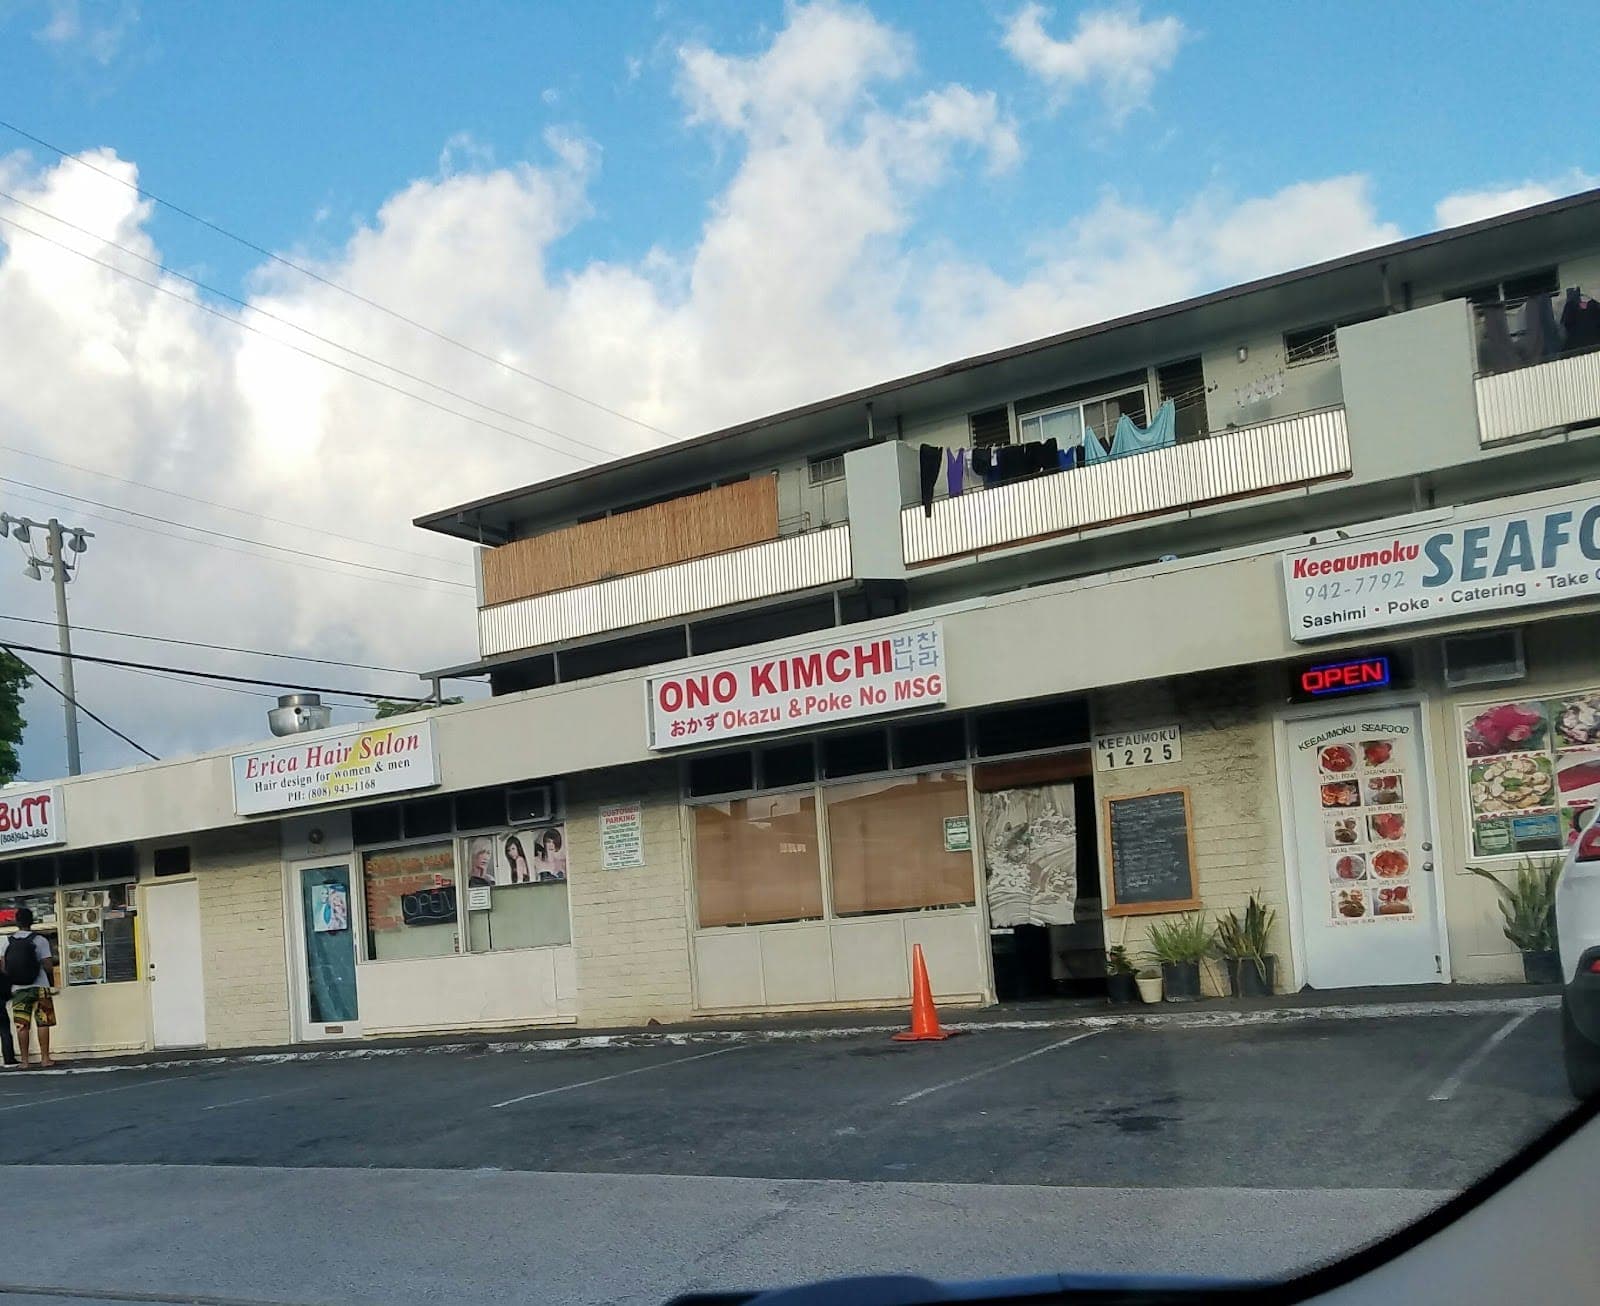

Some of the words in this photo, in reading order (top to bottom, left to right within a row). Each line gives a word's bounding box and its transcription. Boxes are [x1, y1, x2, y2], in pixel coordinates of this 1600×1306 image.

[1293, 541, 1420, 579] Keeaumoku
[1302, 606, 1367, 628] Sashimi
[1388, 598, 1430, 614] Poke
[1451, 581, 1527, 603] Catering
[1547, 572, 1589, 590] Take
[1304, 571, 1405, 604] 942-7792
[659, 671, 738, 712] ONO
[750, 640, 893, 697] KIMCHI
[1302, 662, 1384, 691] OPEN
[723, 706, 781, 729] Okazu
[859, 686, 887, 706] No
[894, 674, 942, 701] MSG
[670, 712, 719, 738] おかず
[1098, 728, 1176, 751] KEEAUMOKU
[1298, 724, 1356, 751] KEEAUMOKU
[1361, 723, 1410, 734] SEAFOOD
[245, 754, 298, 779] Erica
[306, 742, 352, 769] Hair
[359, 732, 420, 760] Salon
[255, 780, 278, 793] Hair
[281, 775, 312, 789] design
[315, 772, 331, 783] for
[334, 766, 371, 779] women
[374, 762, 384, 773] &
[388, 759, 411, 771] men
[288, 791, 306, 802] PH:
[308, 787, 331, 800] (808)
[334, 779, 376, 795] 943-1168
[403, 890, 456, 917] OPEN
